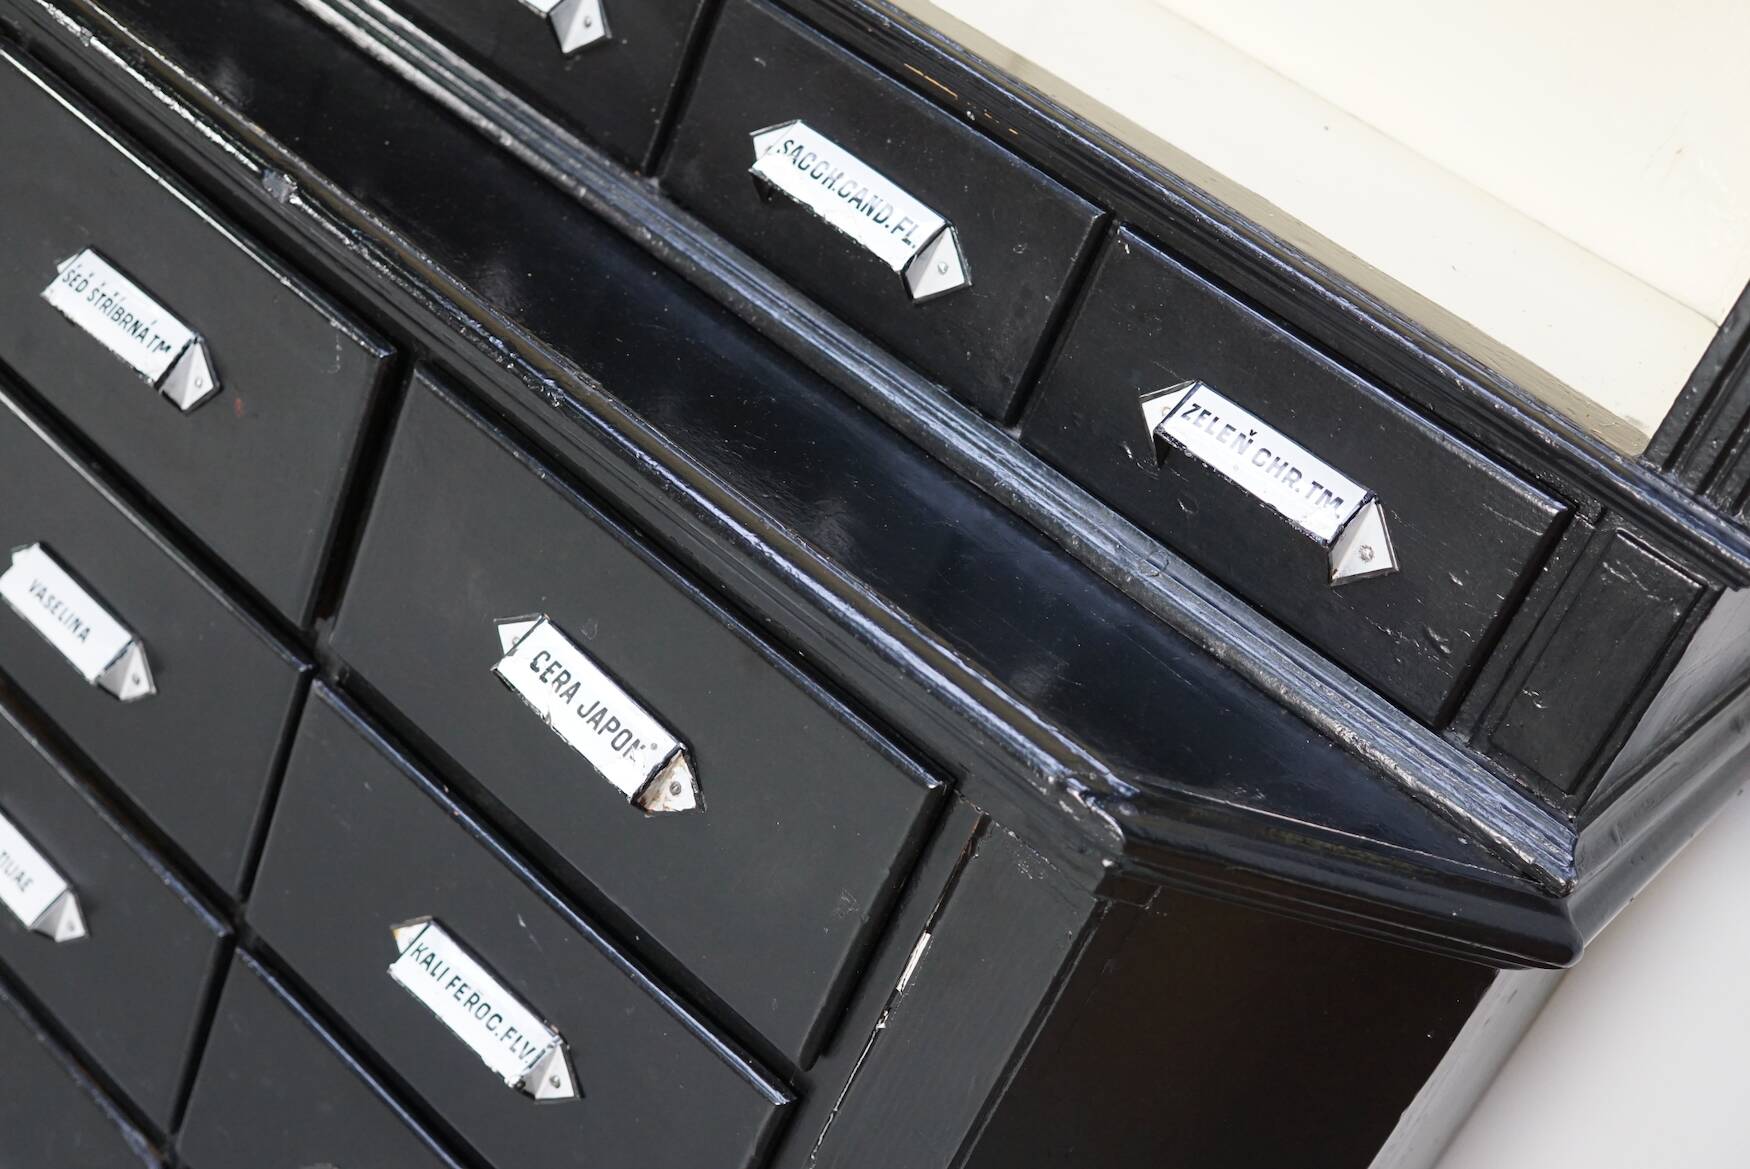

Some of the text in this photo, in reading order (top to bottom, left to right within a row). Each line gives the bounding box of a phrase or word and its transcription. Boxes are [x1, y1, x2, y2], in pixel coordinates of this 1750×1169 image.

[1180, 403, 1257, 456] ZELEŇ
[29, 579, 91, 643] VASELINA
[530, 650, 582, 704] CERA
[410, 942, 450, 982] KALI
